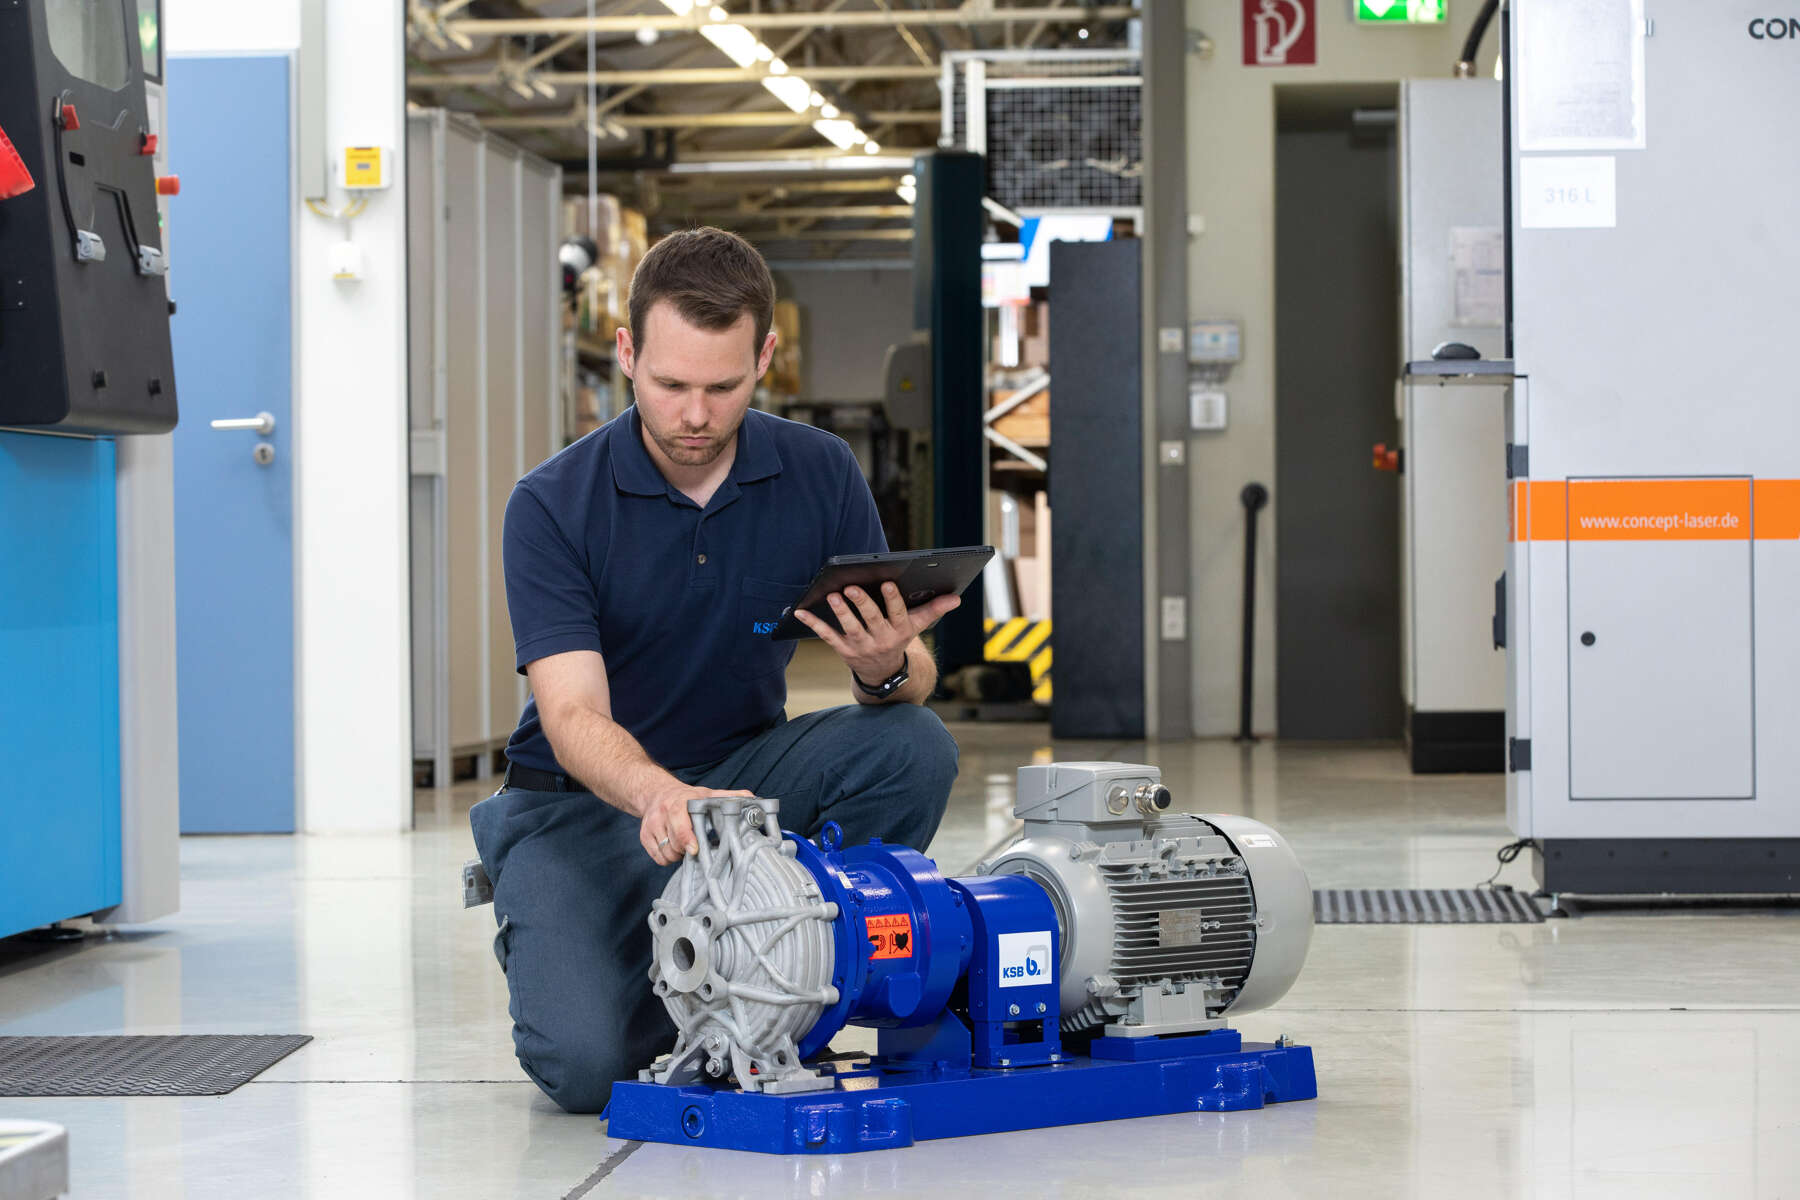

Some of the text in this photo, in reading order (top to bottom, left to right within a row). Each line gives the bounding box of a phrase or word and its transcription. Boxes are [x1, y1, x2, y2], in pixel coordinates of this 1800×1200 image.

[1543, 187, 1596, 204] 316 L
[1580, 512, 1739, 532] www.concept-laser.de
[1002, 966, 1024, 978] KSB
